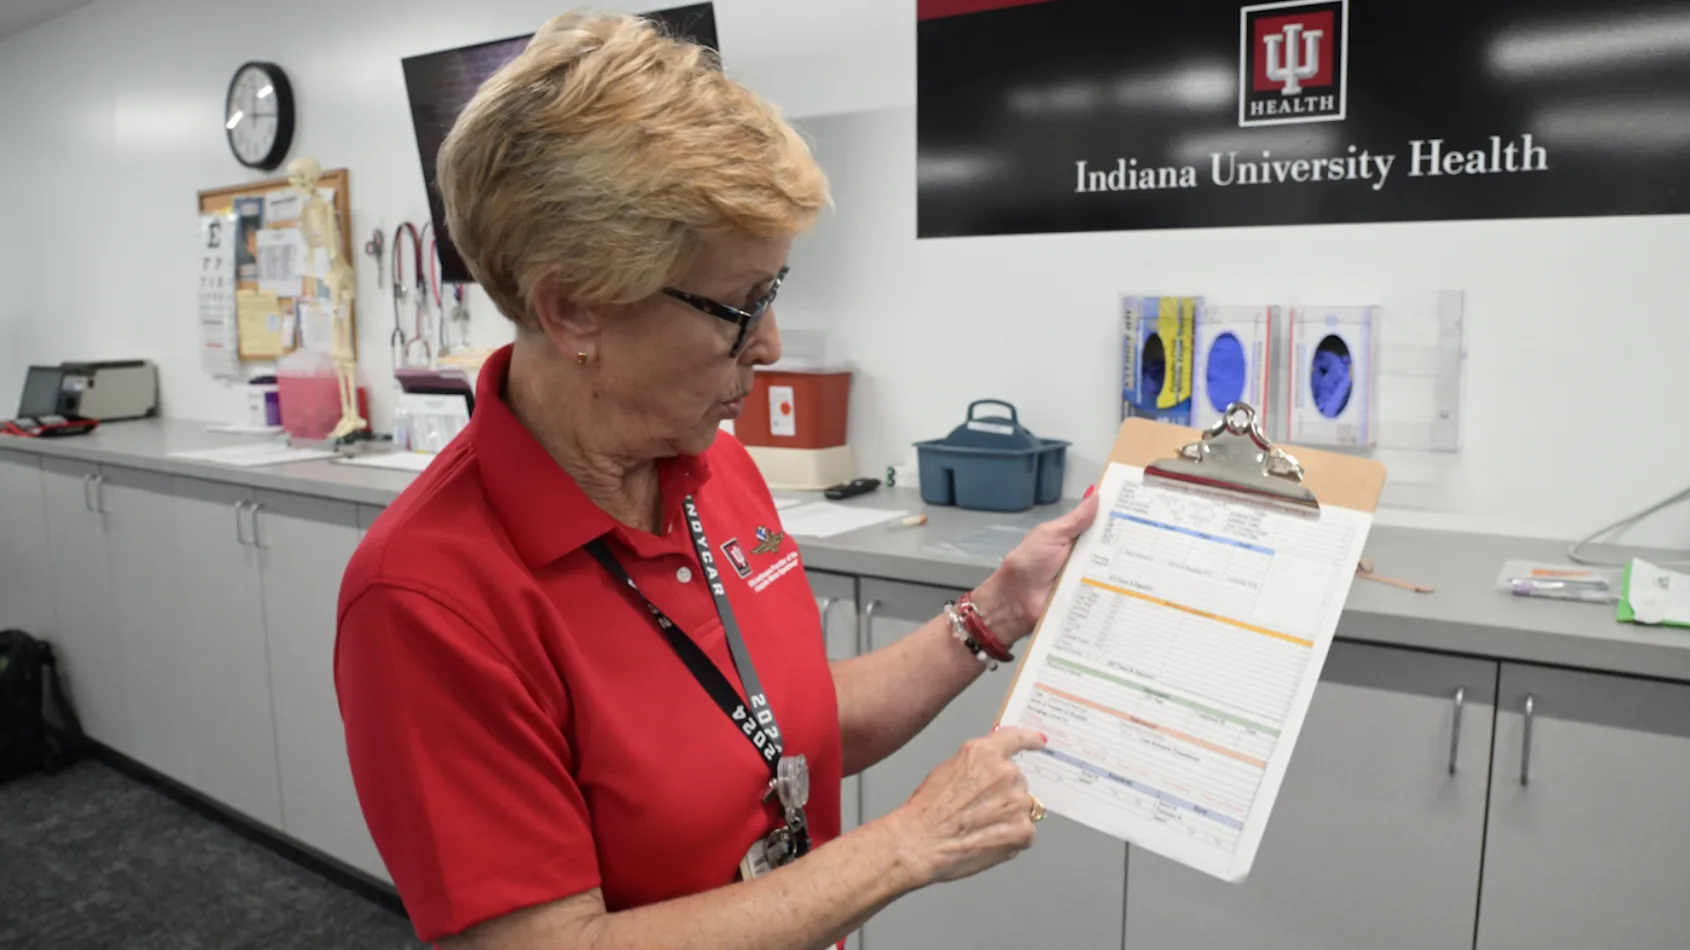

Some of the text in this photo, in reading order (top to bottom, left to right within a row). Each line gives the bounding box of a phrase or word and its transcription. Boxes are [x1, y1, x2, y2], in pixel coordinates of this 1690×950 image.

[1263, 23, 1323, 96] IU
[1250, 95, 1335, 116] HEALTH
[1075, 133, 1549, 193] Indiana University Health
[731, 704, 776, 761] 2024
